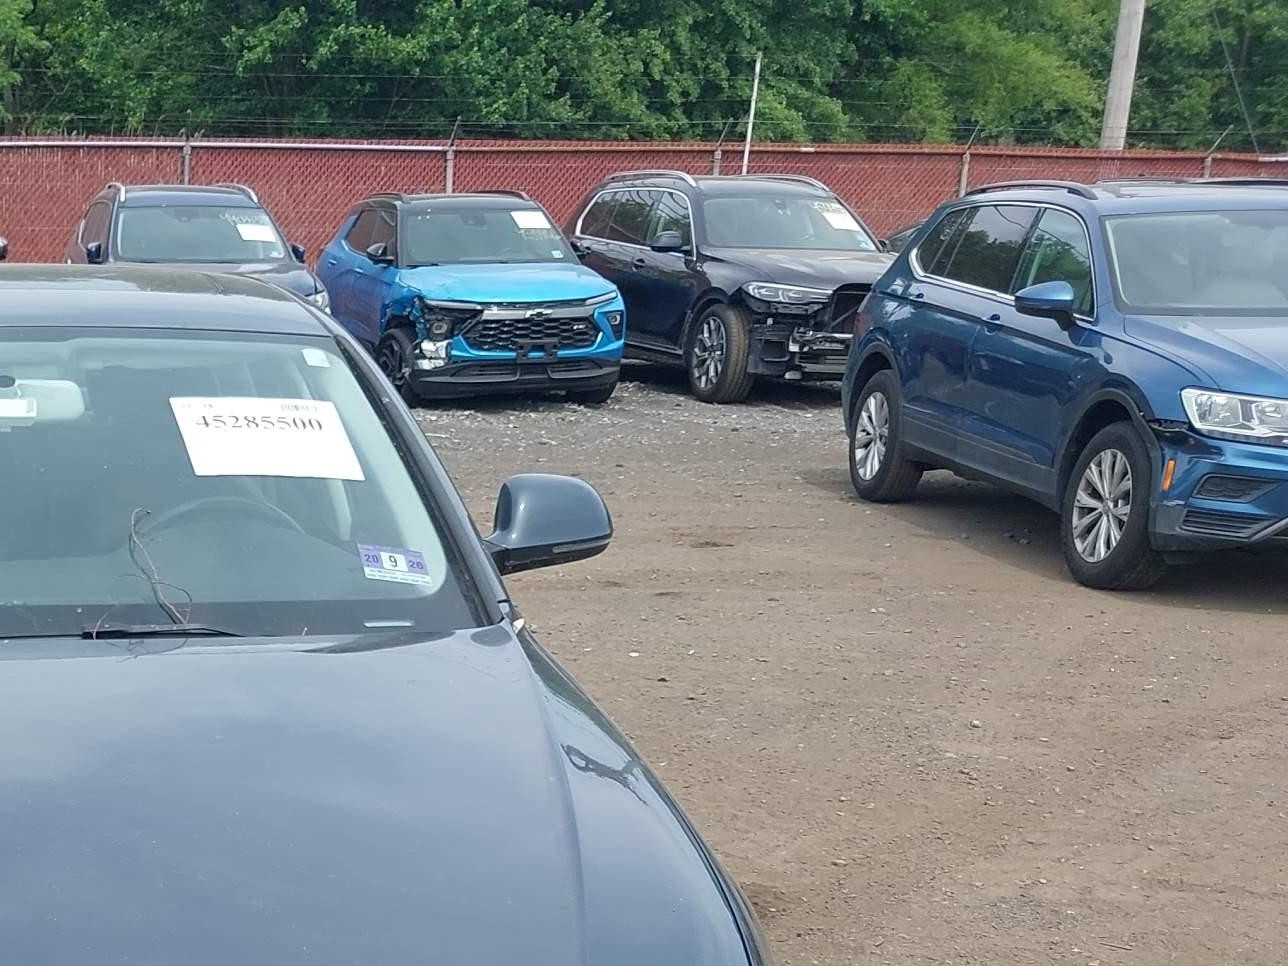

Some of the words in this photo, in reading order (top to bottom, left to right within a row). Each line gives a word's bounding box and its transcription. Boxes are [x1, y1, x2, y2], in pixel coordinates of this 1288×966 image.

[195, 415, 323, 431] 45285500
[363, 553, 379, 564] 20
[388, 555, 398, 568] 9
